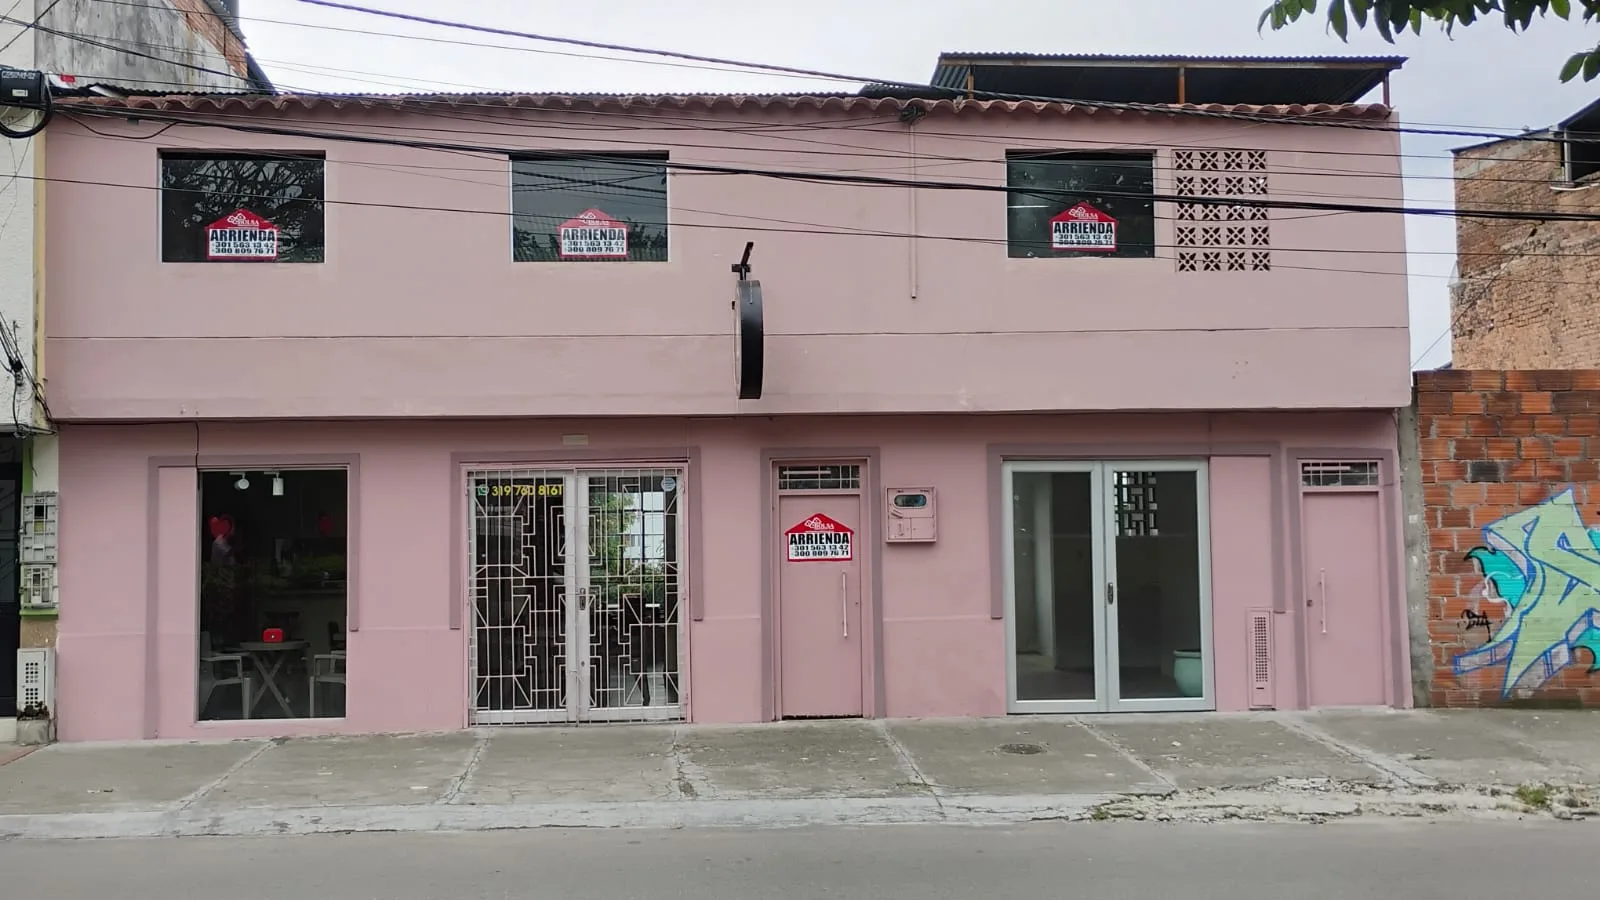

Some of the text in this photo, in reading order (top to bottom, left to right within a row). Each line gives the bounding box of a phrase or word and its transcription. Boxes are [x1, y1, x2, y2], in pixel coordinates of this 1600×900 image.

[1054, 223, 1113, 233] ARRIENDA
[210, 230, 275, 241] ARRIENDA
[563, 229, 625, 240] ARRIENDA
[491, 484, 562, 496] 319 760 8161
[790, 533, 850, 545] ARRIENDA
